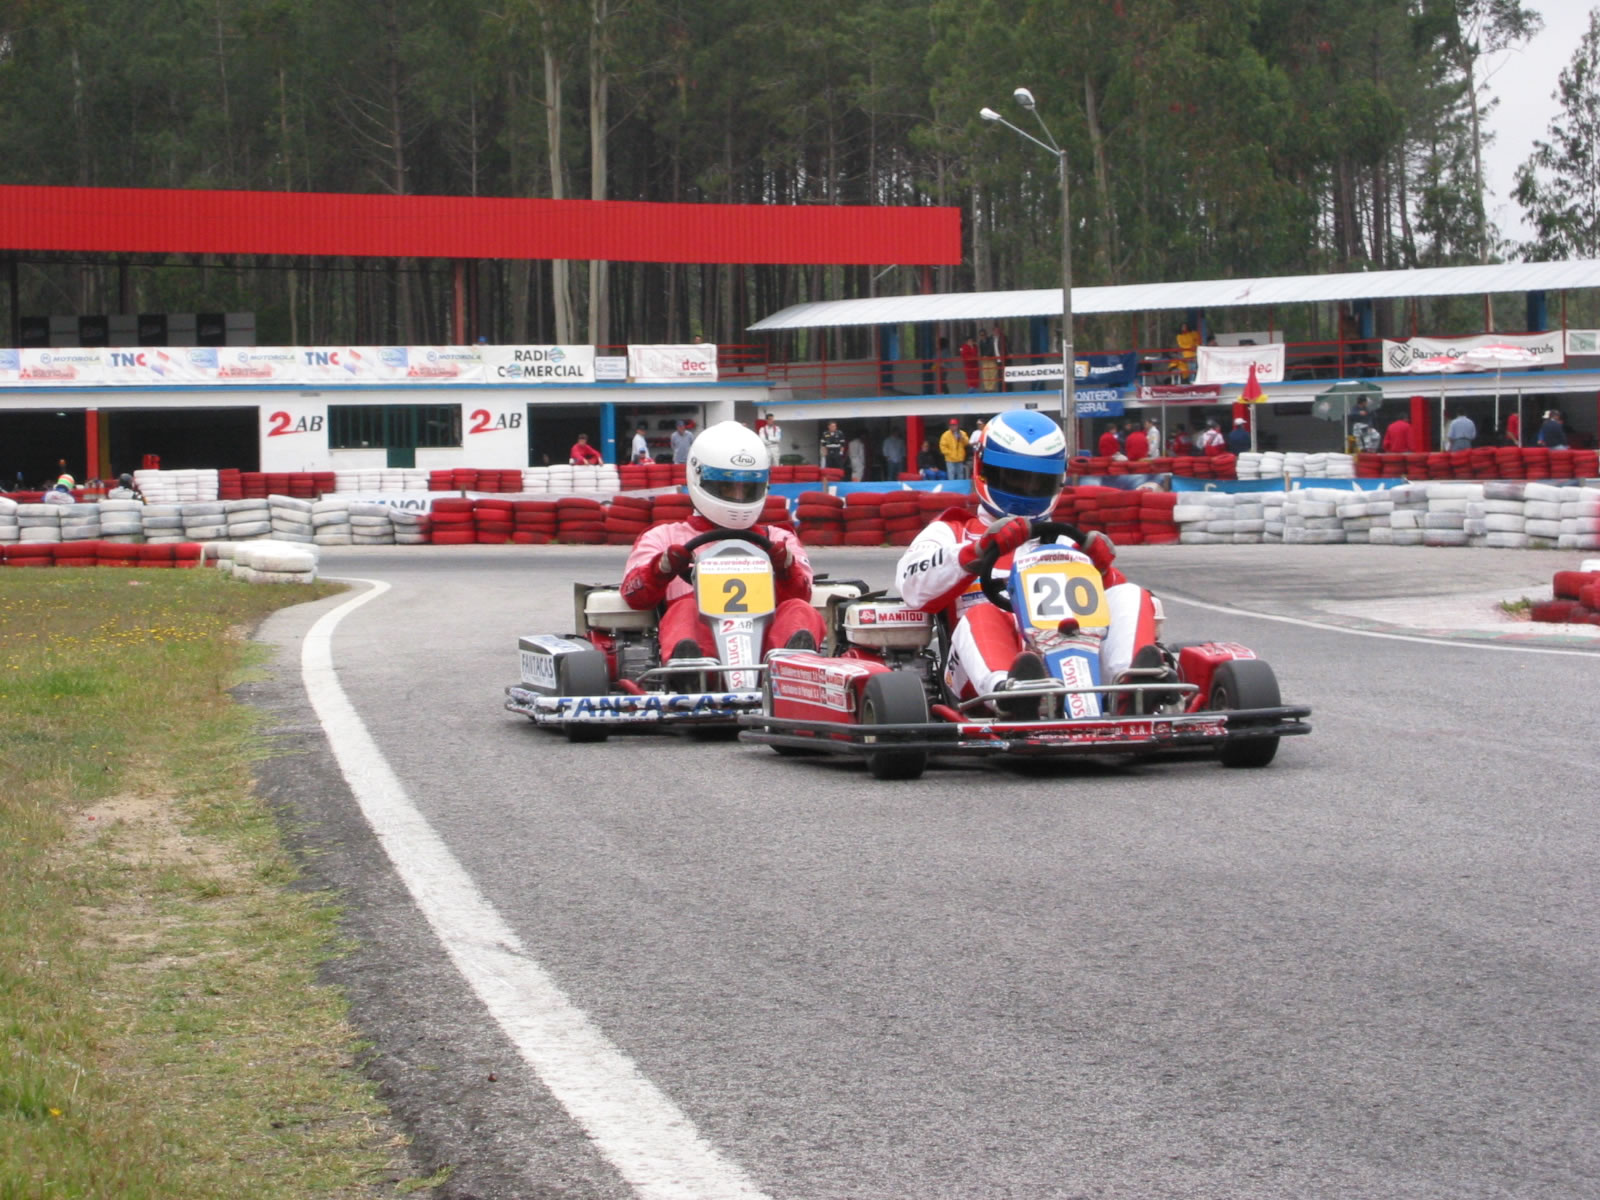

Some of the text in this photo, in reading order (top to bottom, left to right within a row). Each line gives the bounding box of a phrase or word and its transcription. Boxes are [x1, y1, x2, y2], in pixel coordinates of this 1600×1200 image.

[110, 353, 147, 367] TNC
[305, 351, 340, 366] TNC
[682, 359, 707, 371] dec
[1075, 390, 1118, 401] ONTEPIO
[722, 578, 749, 613] 2
[1033, 577, 1099, 616] 20
[878, 610, 924, 622] MANITOU
